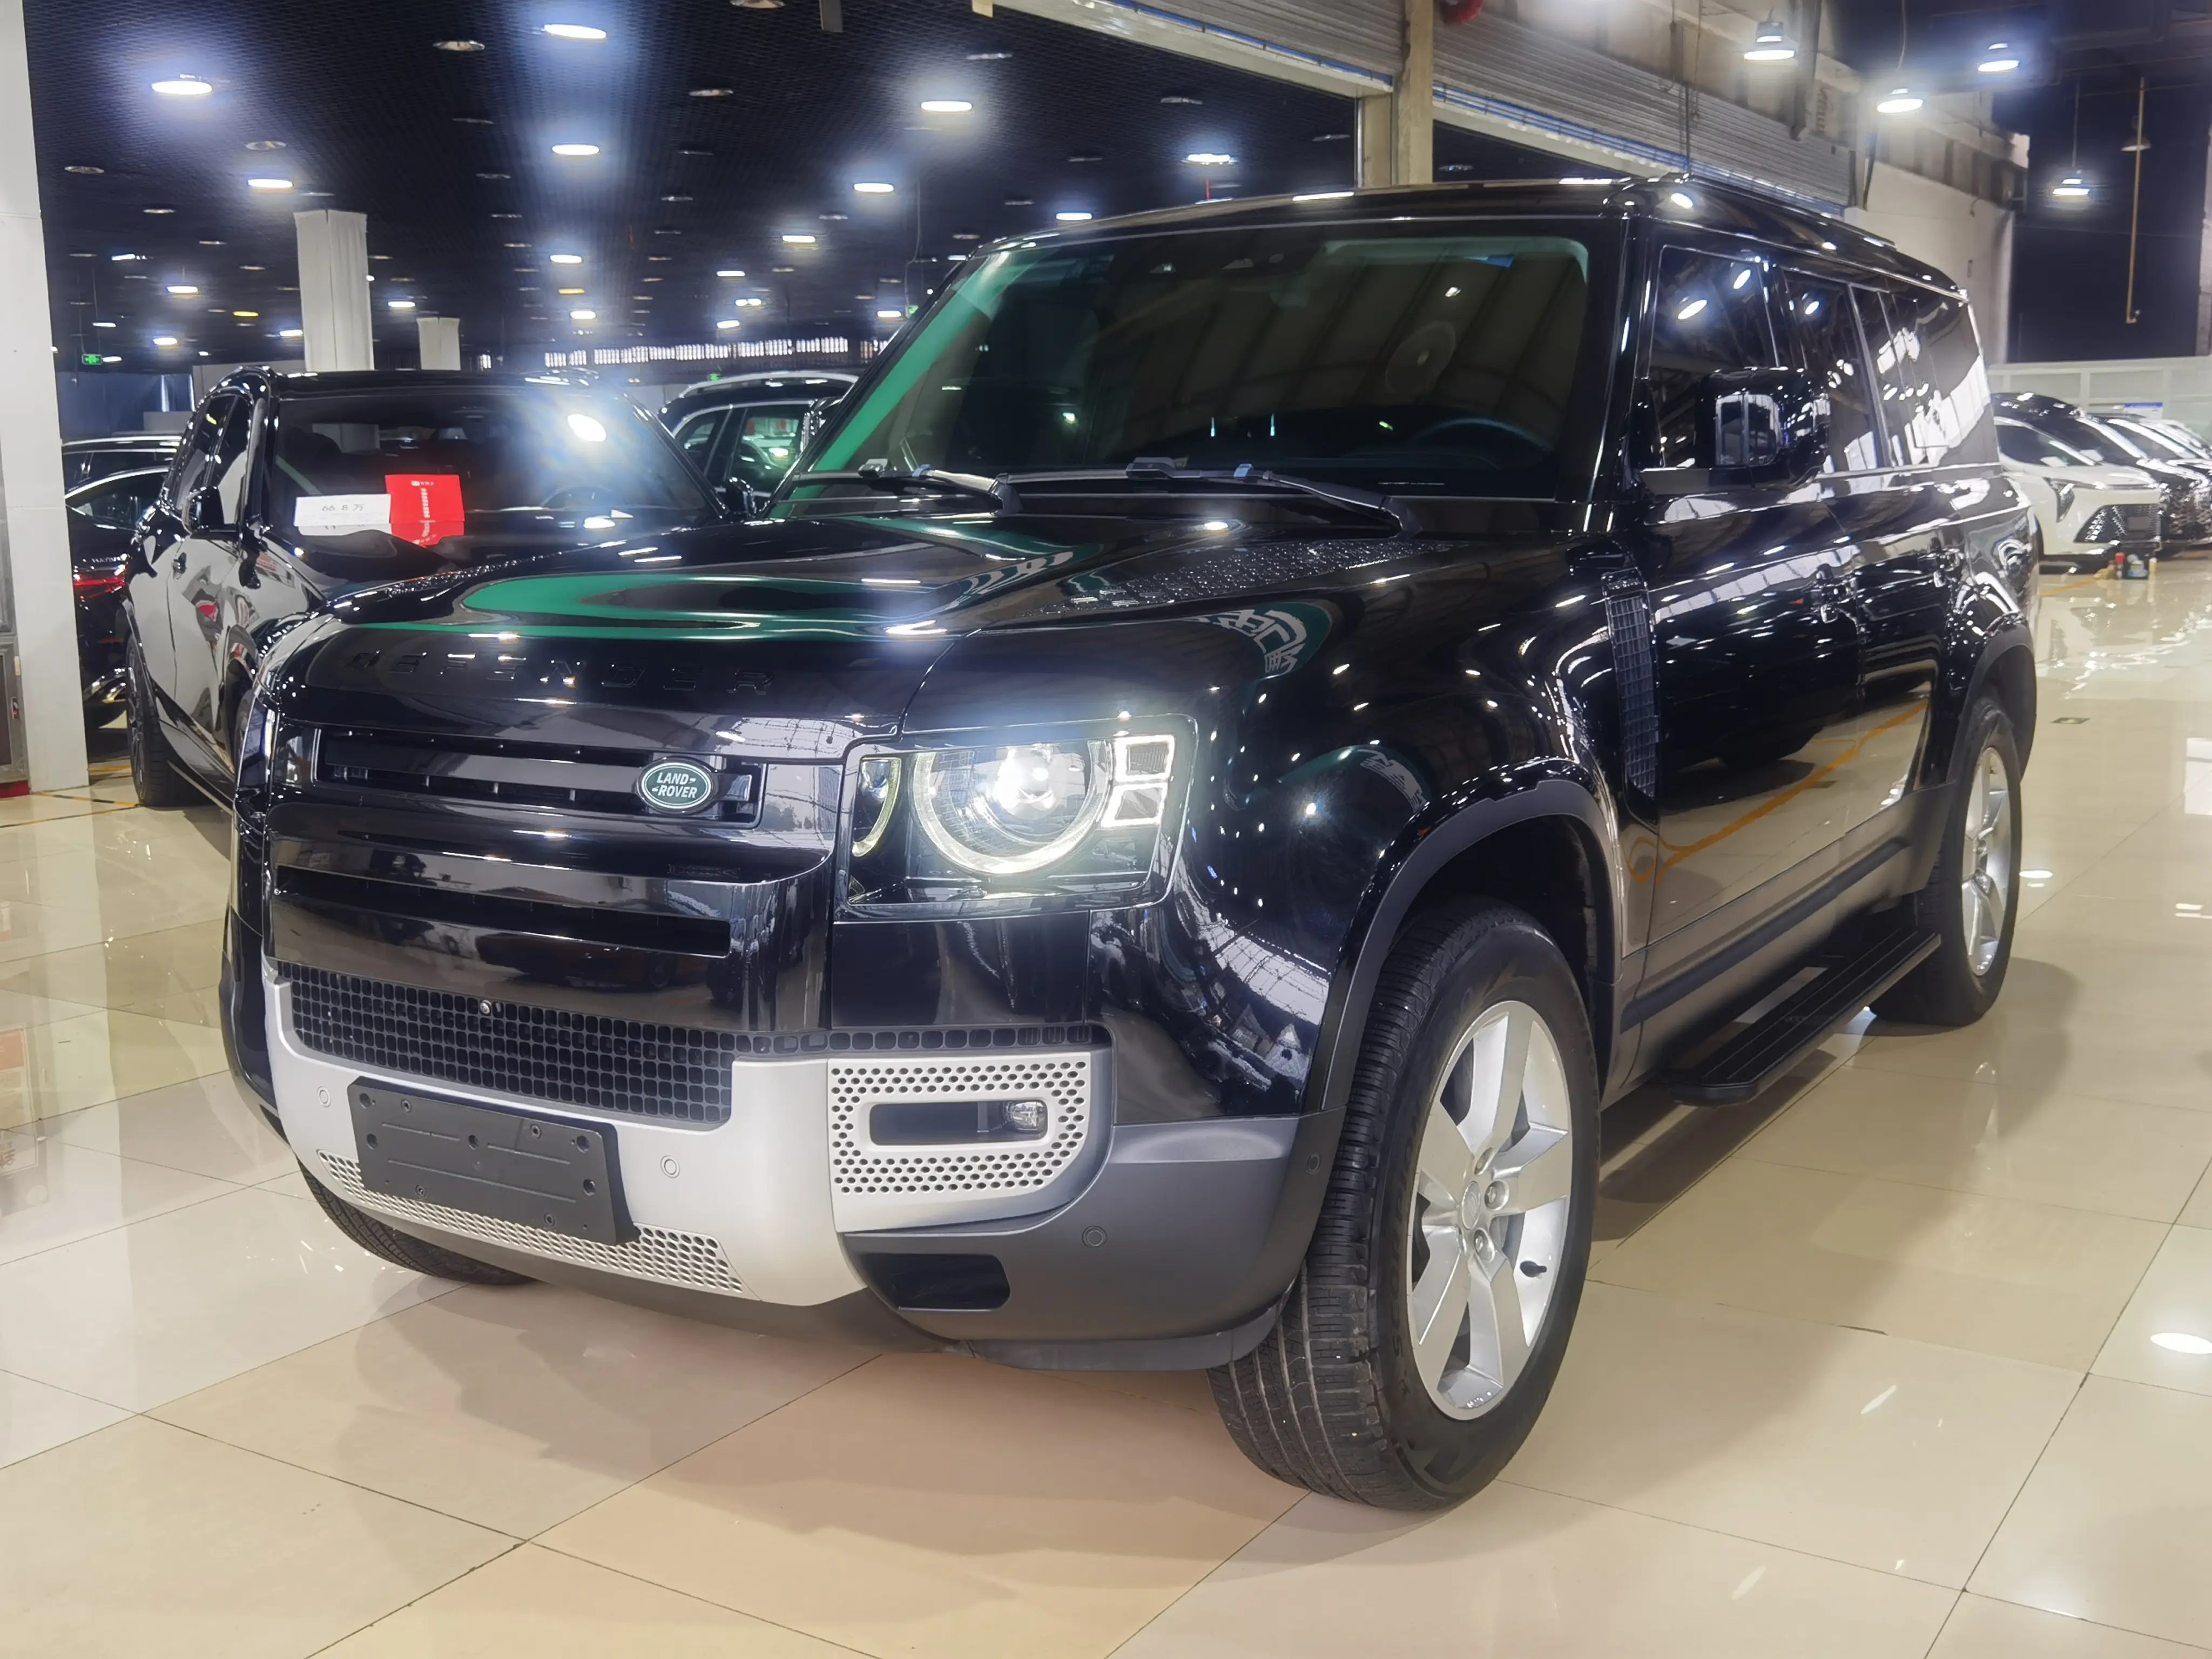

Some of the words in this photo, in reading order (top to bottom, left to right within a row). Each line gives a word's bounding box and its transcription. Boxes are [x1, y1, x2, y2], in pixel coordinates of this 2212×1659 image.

[345, 649, 774, 695] DEFENDER
[657, 772, 689, 785] LAND
[658, 785, 697, 798] ROVER
